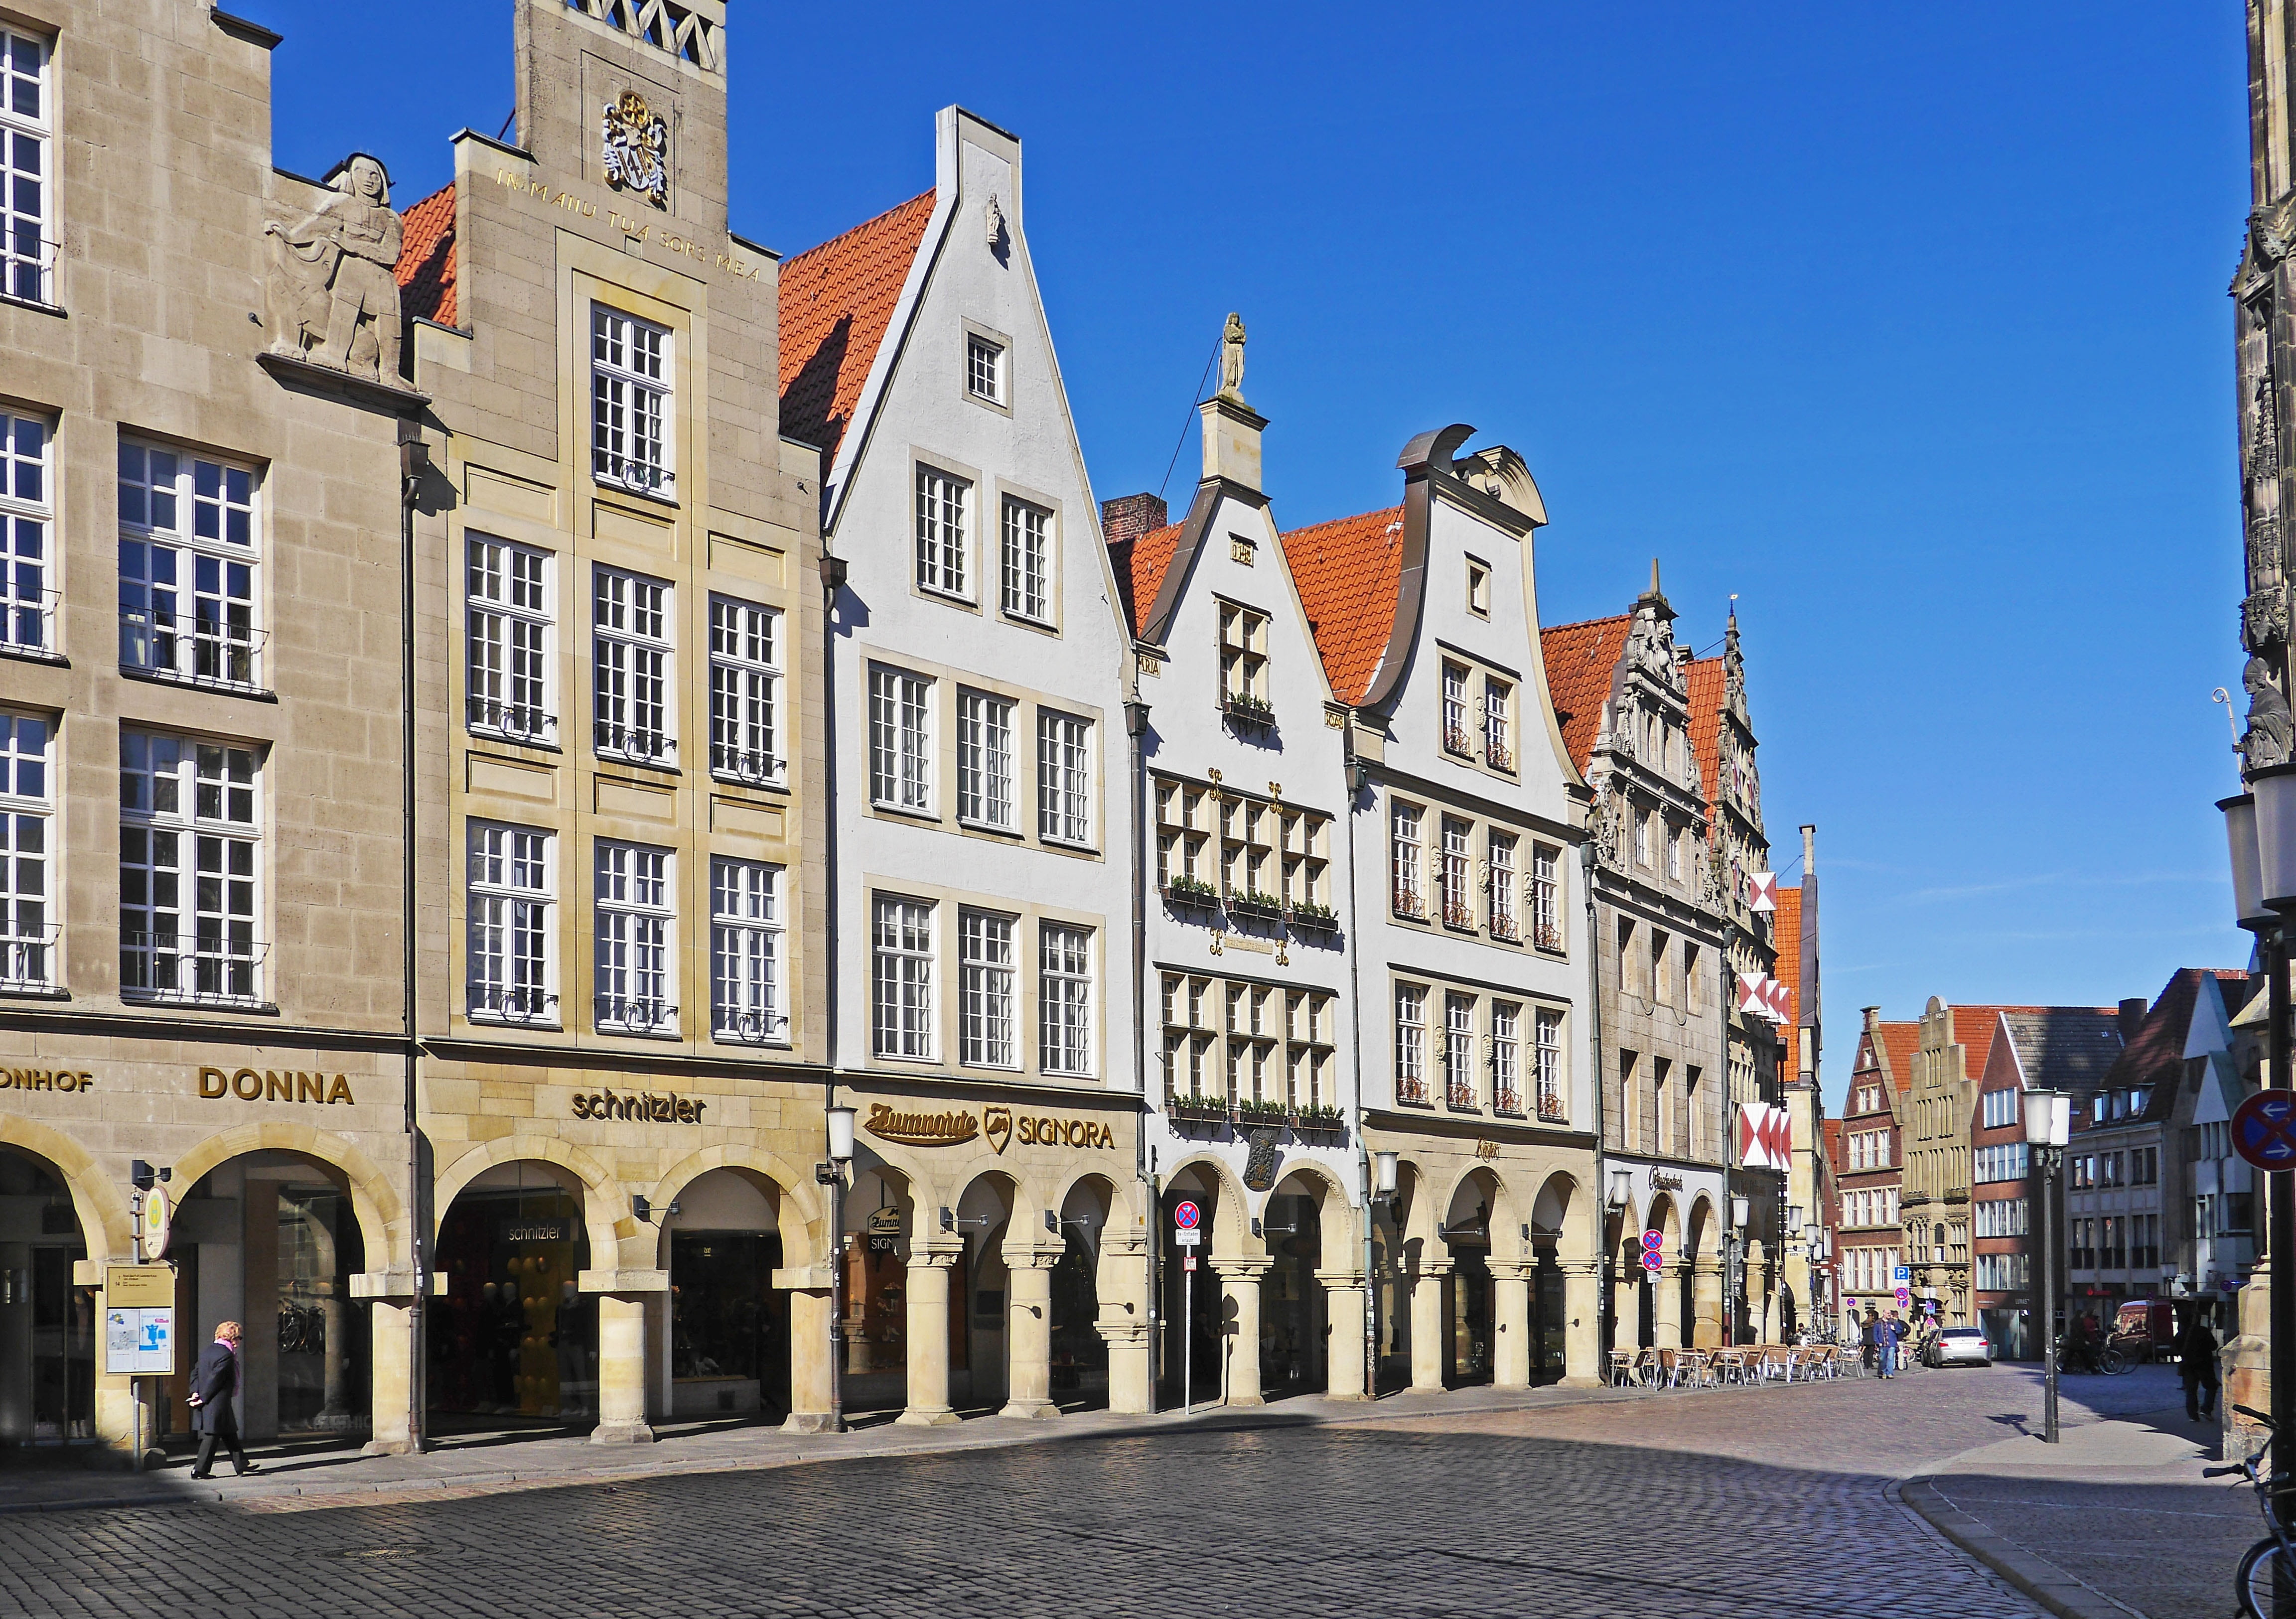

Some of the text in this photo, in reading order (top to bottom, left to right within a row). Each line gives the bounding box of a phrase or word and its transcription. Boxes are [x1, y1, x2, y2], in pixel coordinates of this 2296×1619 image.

[496, 168, 760, 283] IN MANU TUA SORS MEA
[199, 1067, 355, 1105] DONNA
[572, 1086, 705, 1122] schnitzler
[866, 1102, 1116, 1149] Zumnorde SIGNORA
[509, 1223, 562, 1240] schnitzler
[1897, 1268, 1905, 1278] P
